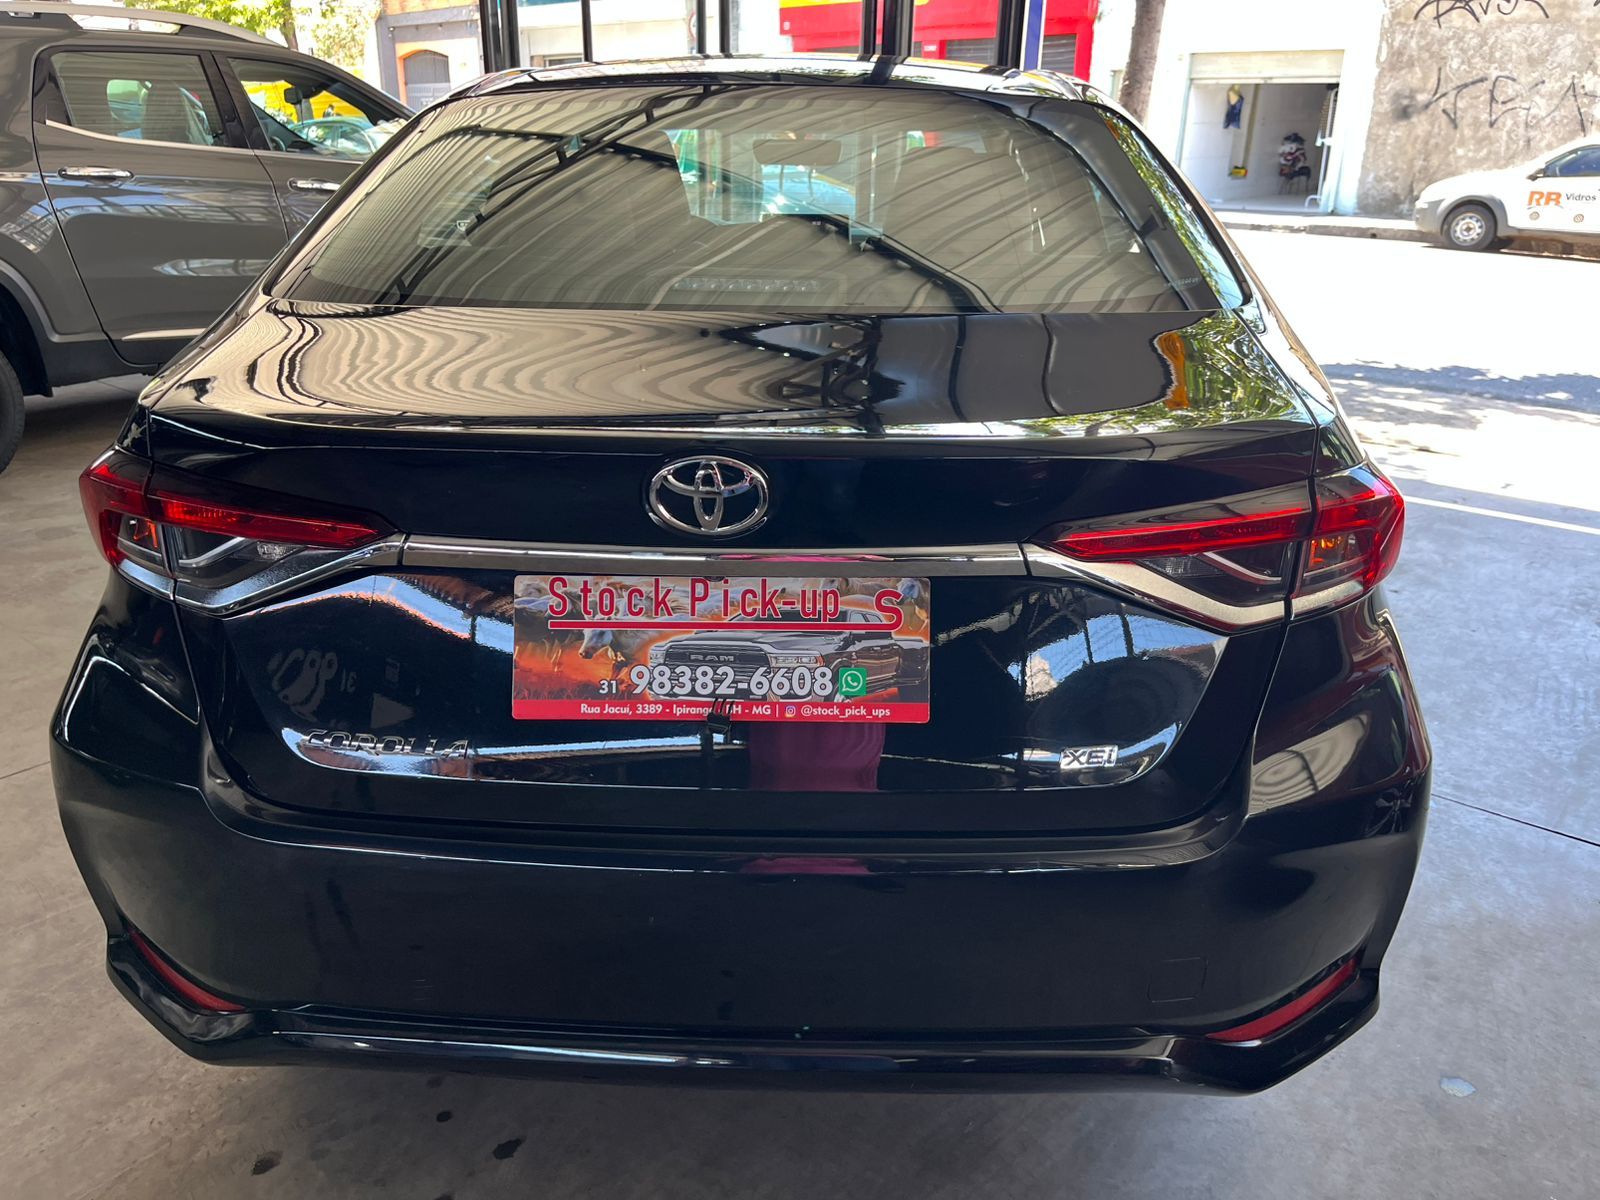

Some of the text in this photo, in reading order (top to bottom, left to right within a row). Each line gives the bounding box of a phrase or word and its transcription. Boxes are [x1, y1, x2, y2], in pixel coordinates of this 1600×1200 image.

[1528, 191, 1597, 206] RR Vidros
[547, 576, 674, 618] Stock
[688, 577, 841, 622] Pick-up
[690, 654, 735, 662] RAM
[598, 665, 833, 696] 31 98382-6608
[580, 703, 601, 714] Rua
[603, 703, 633, 716] Jacuí,
[635, 703, 663, 715] 3389
[751, 704, 772, 715] MG
[801, 705, 891, 719] @stock_pick_ups
[302, 728, 470, 760] COROLLA
